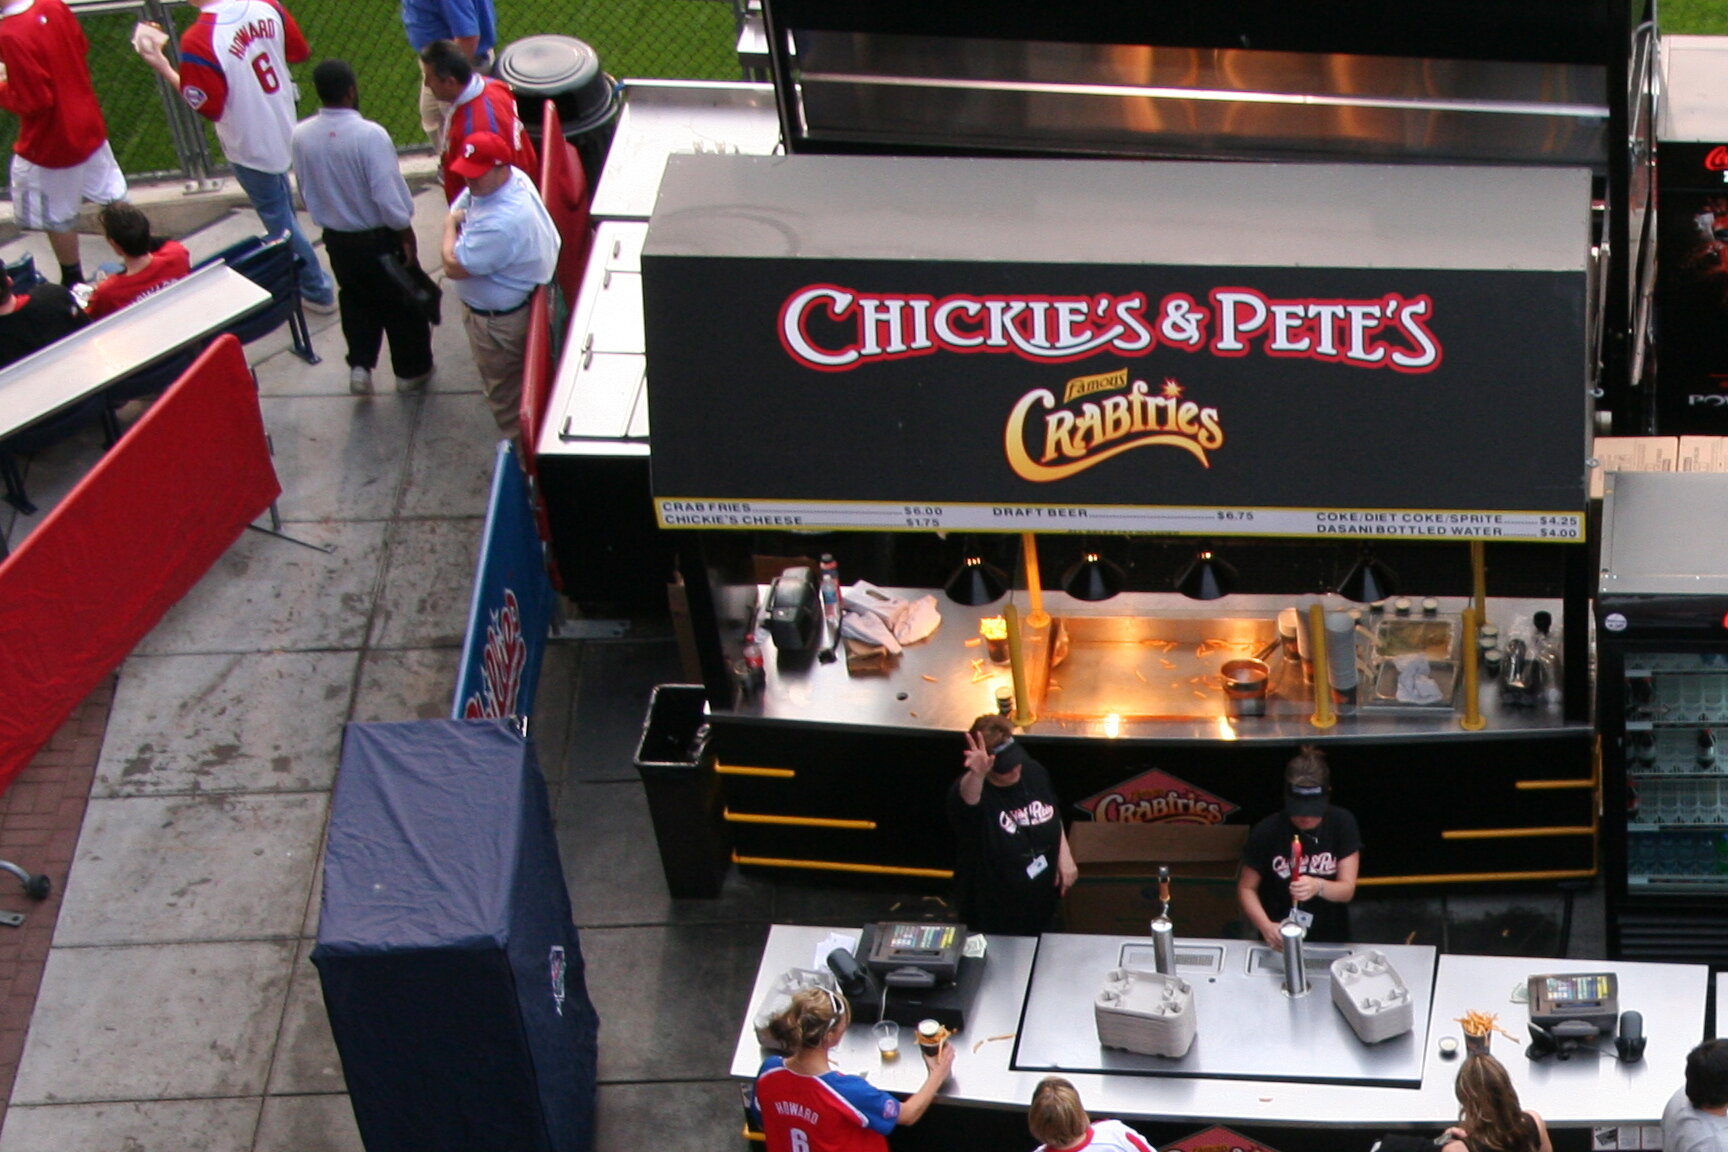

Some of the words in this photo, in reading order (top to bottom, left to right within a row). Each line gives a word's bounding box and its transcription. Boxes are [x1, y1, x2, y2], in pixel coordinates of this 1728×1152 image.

[229, 18, 275, 60] HOWARD
[252, 52, 280, 94] 6
[781, 286, 1153, 367] CHICKIE'S
[1163, 298, 1205, 345] &
[1213, 289, 1438, 369] PETE'S
[662, 502, 705, 512] CRAB
[709, 503, 751, 513] FRIES
[904, 506, 943, 516] $6.00
[993, 507, 1043, 517] DRAFT
[1047, 508, 1088, 518] BEER
[1217, 511, 1254, 521] $6.75
[665, 514, 738, 525] CHICKIE'S
[742, 515, 802, 526] CHEESE
[906, 517, 940, 527] $1.75
[1316, 512, 1397, 522] COKE/DIET
[1402, 513, 1503, 524] COKE/SPRITE
[1539, 516, 1578, 526] $4.25
[1316, 524, 1373, 534] DASANI
[1376, 524, 1447, 535] BOTTLED
[1451, 526, 1503, 536] WATER
[1540, 527, 1577, 538] $4.00
[774, 1100, 819, 1125] HOWARD
